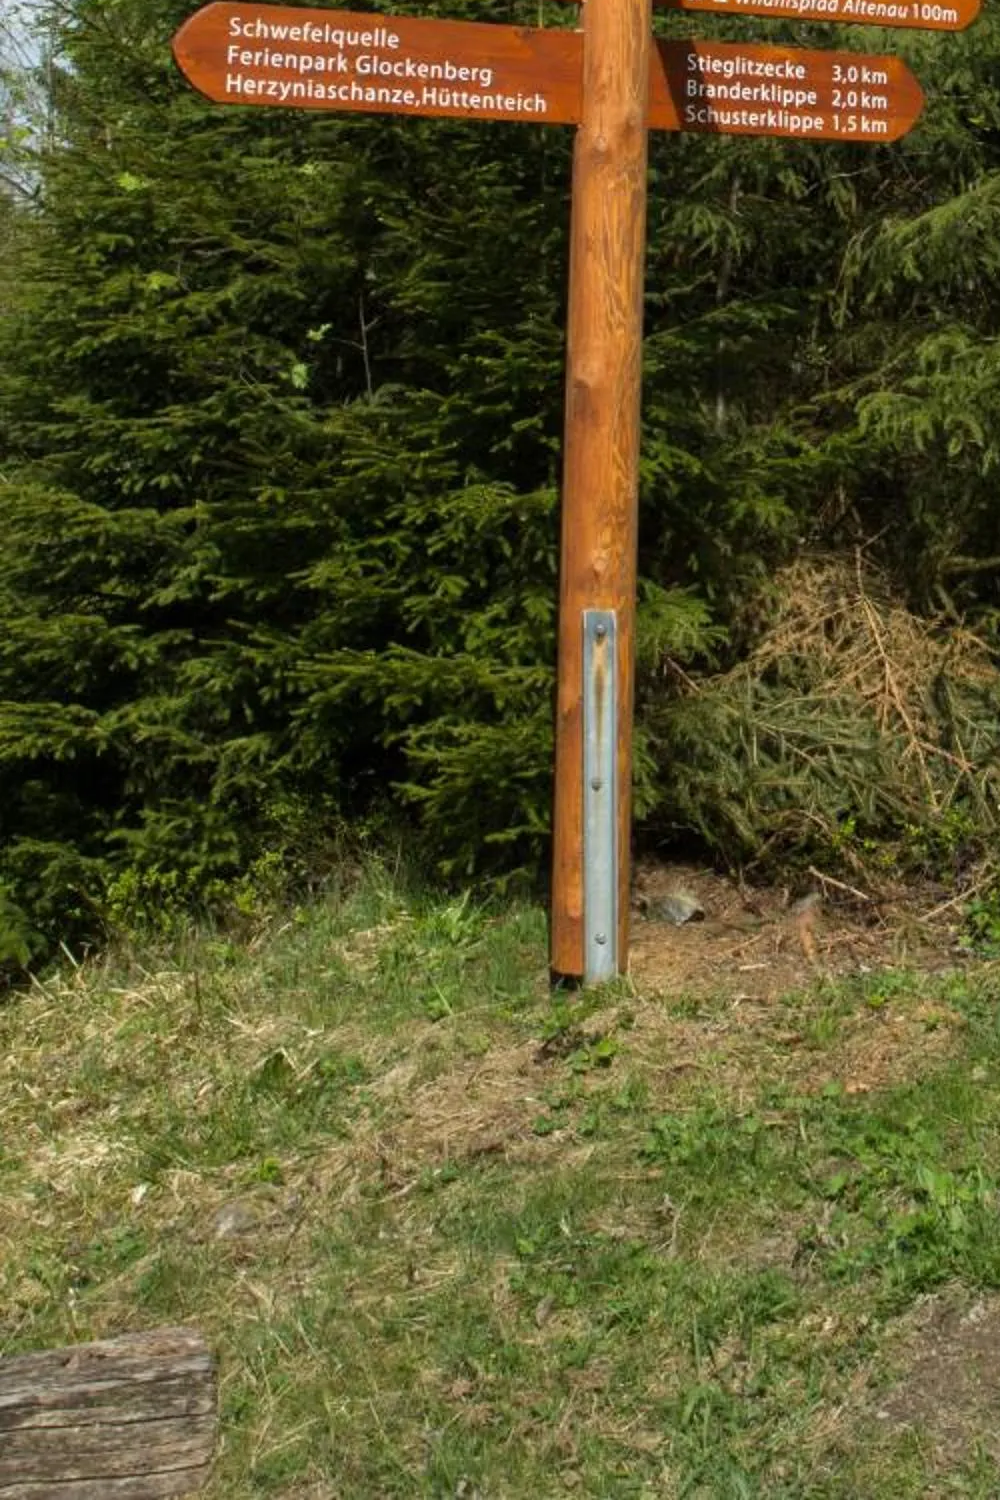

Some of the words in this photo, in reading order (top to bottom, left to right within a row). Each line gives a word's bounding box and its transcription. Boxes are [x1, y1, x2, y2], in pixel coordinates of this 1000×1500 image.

[913, 2, 958, 23] 100m
[229, 16, 400, 49] Schwefelquelle
[227, 45, 348, 74] Ferienpark
[355, 54, 494, 88] Glockenberg
[687, 53, 806, 80] Stieglitzecke
[832, 65, 858, 85] 3,0
[861, 66, 888, 85] km
[687, 79, 817, 108] Branderklippe
[831, 90, 857, 109] 2,0
[861, 91, 888, 109] km
[685, 104, 825, 133] Schusterklippe
[832, 114, 857, 133] 1,5
[861, 115, 888, 134] km
